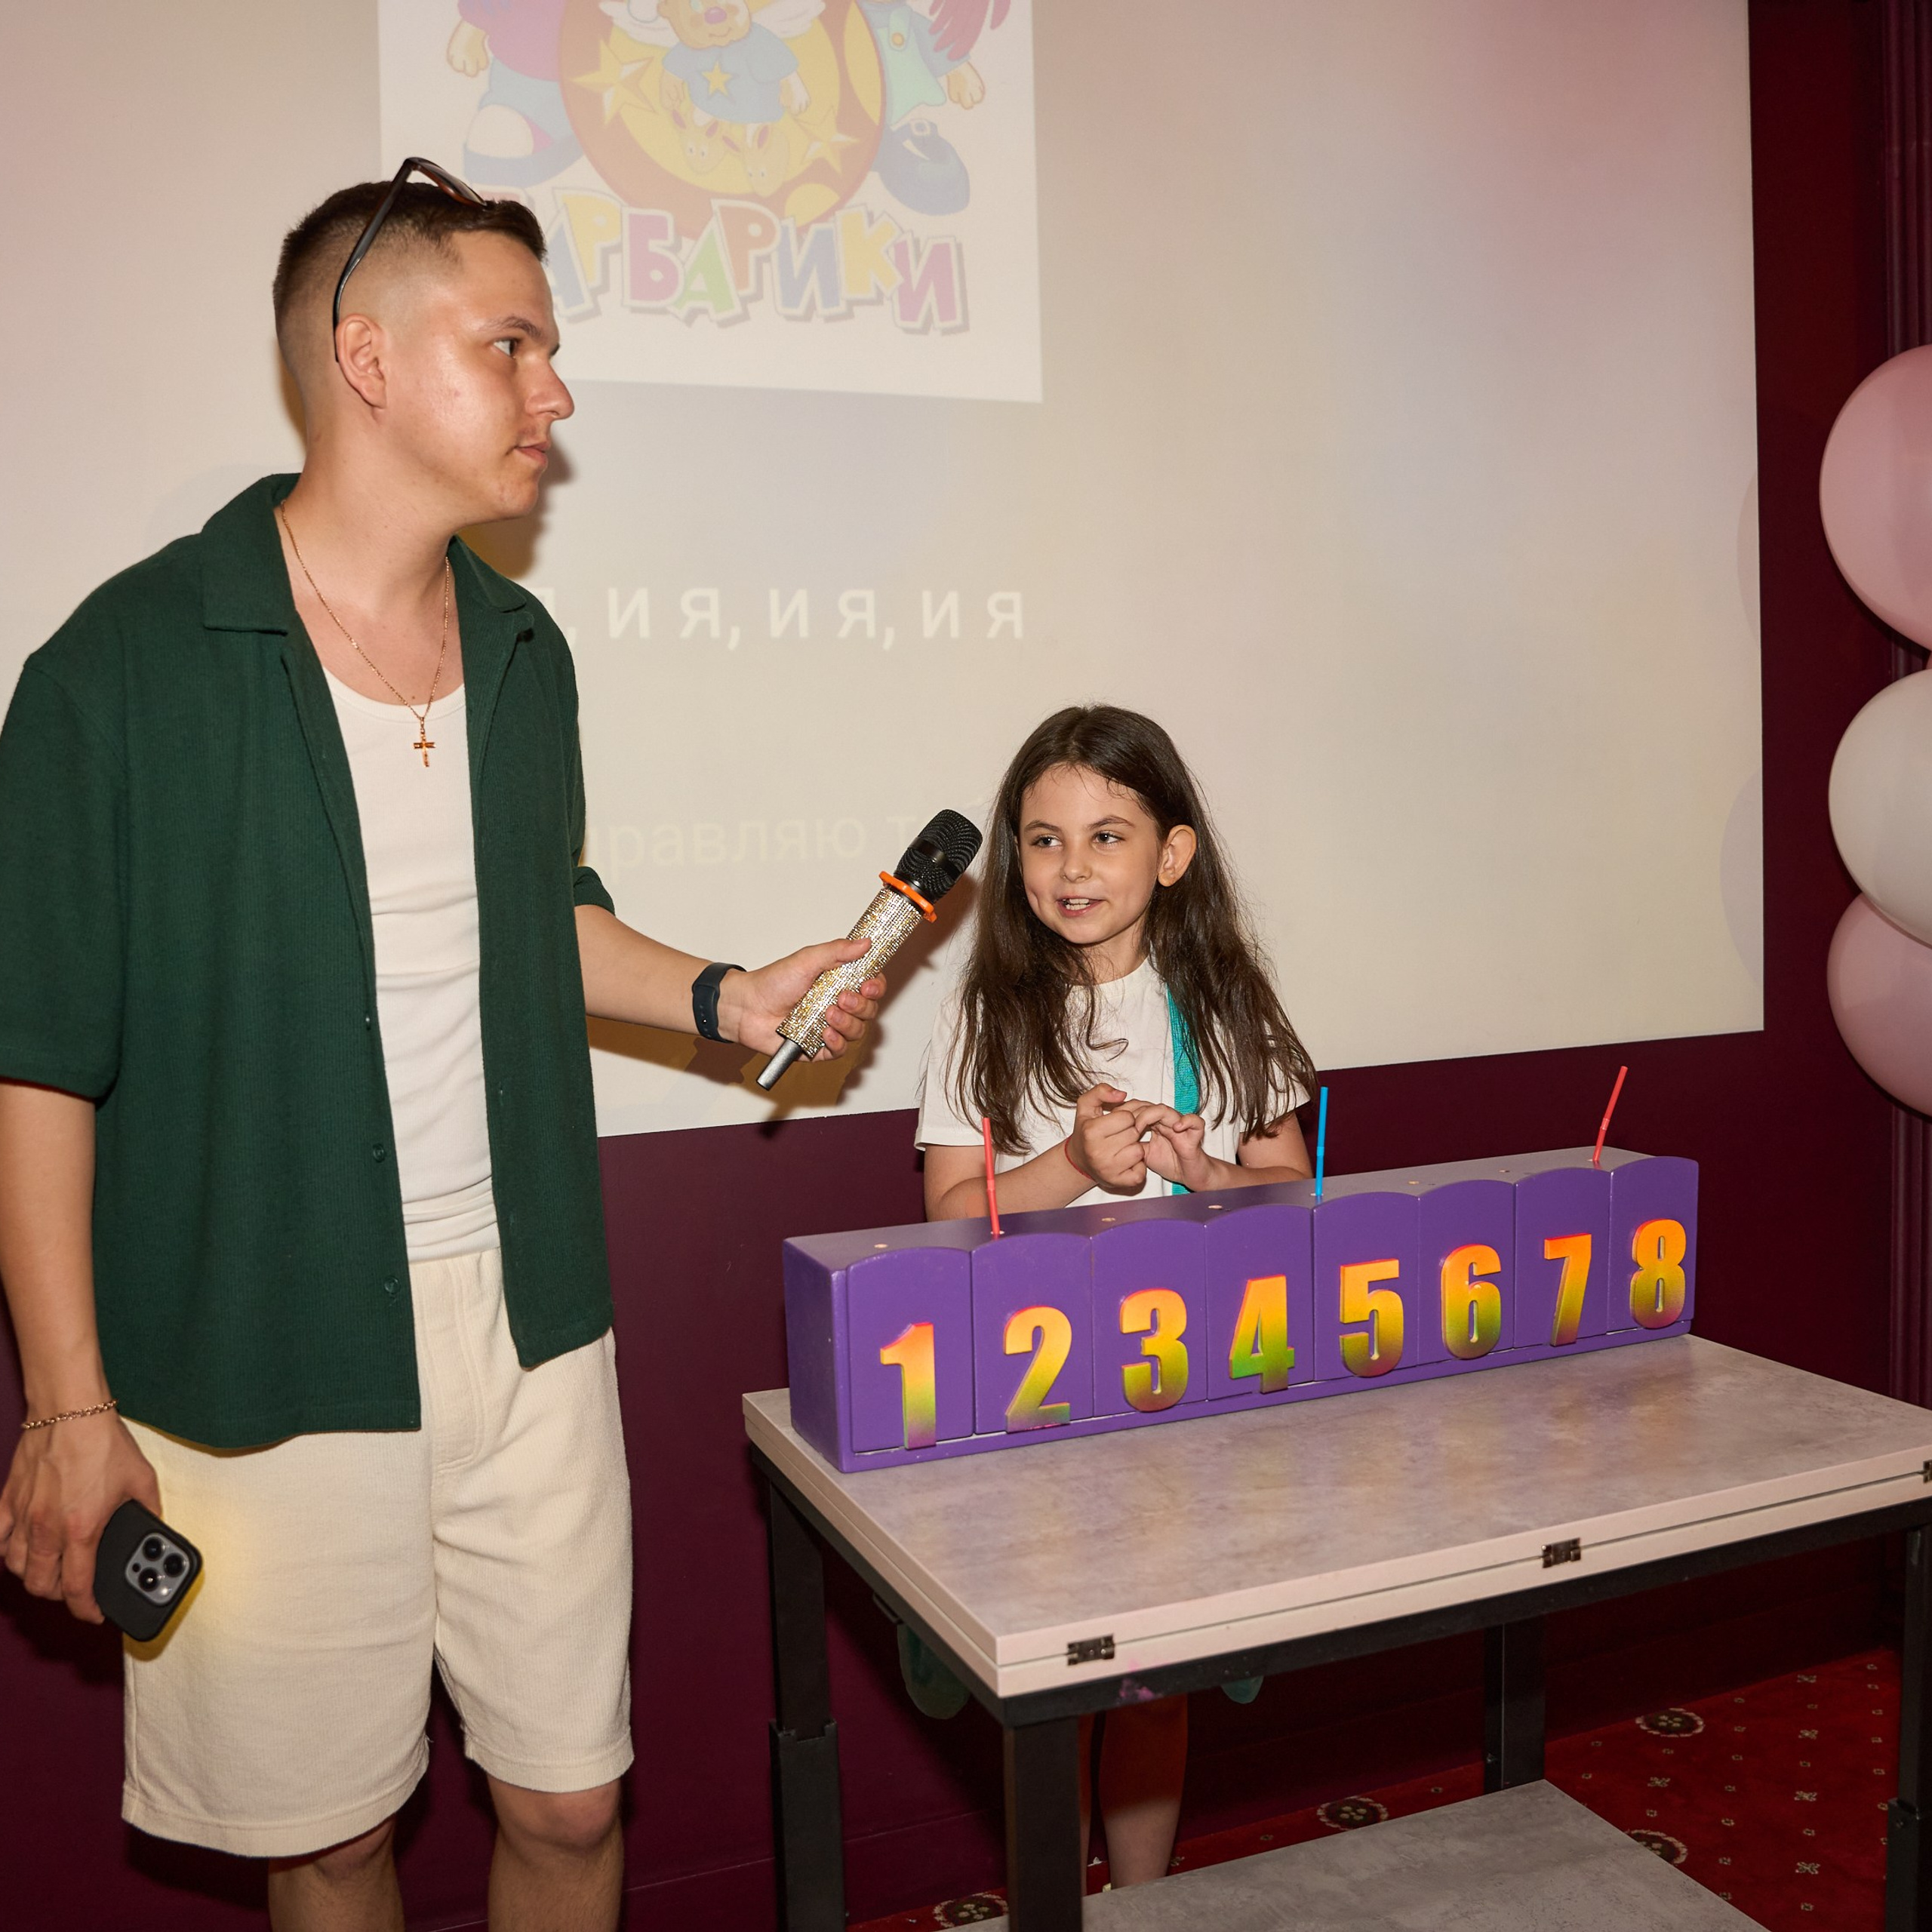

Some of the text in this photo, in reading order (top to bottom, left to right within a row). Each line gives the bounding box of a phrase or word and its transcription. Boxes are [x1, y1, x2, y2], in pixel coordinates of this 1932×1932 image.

[475, 183, 971, 334] АРБАРИКИ
[589, 817, 866, 884] равляю
[880, 1218, 1687, 1450] 1 2 3 4 5 6 7 8
